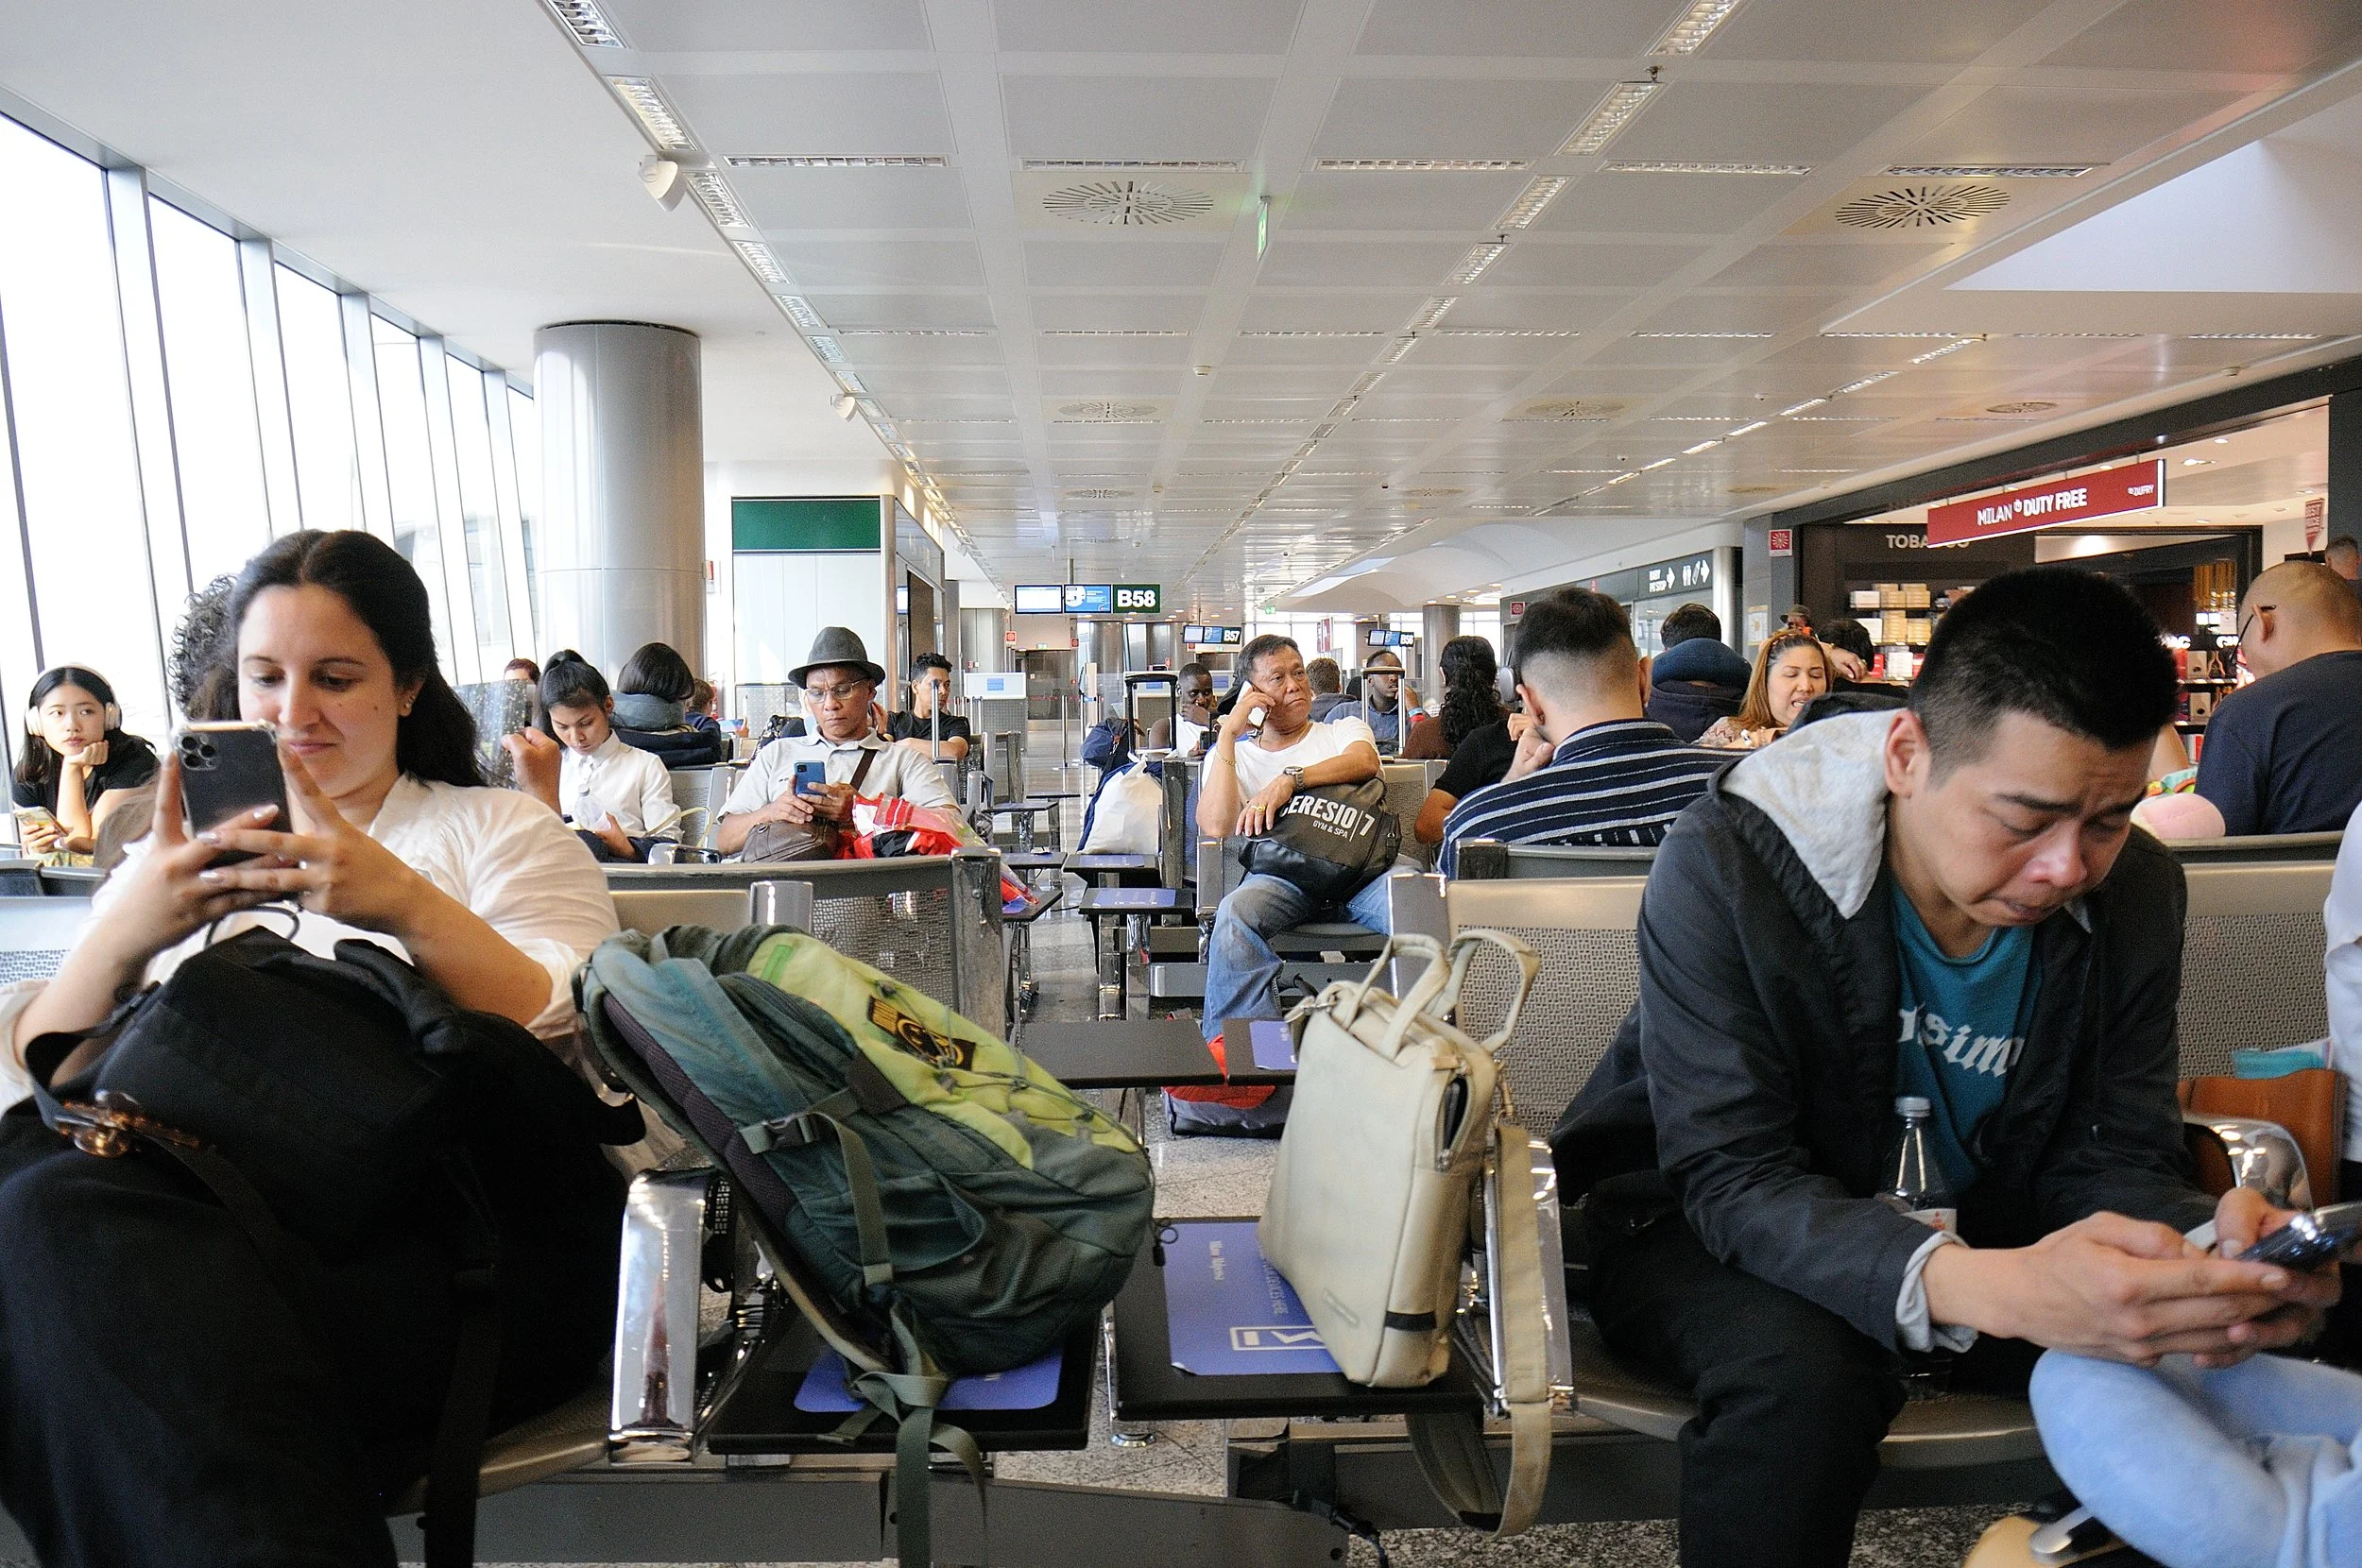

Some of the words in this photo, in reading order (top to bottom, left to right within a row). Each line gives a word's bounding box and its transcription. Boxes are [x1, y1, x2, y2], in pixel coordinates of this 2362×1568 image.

[1977, 503, 2012, 526] MILAN
[2023, 494, 2055, 517] DUTY
[2055, 487, 2088, 511] FREE
[1885, 534, 1970, 549] TOBA
[1117, 589, 1156, 608] B58
[1224, 630, 1241, 642] B57
[1312, 820, 1326, 831] GYM
[1326, 825, 1333, 833] &
[1333, 827, 1349, 839] SPA
